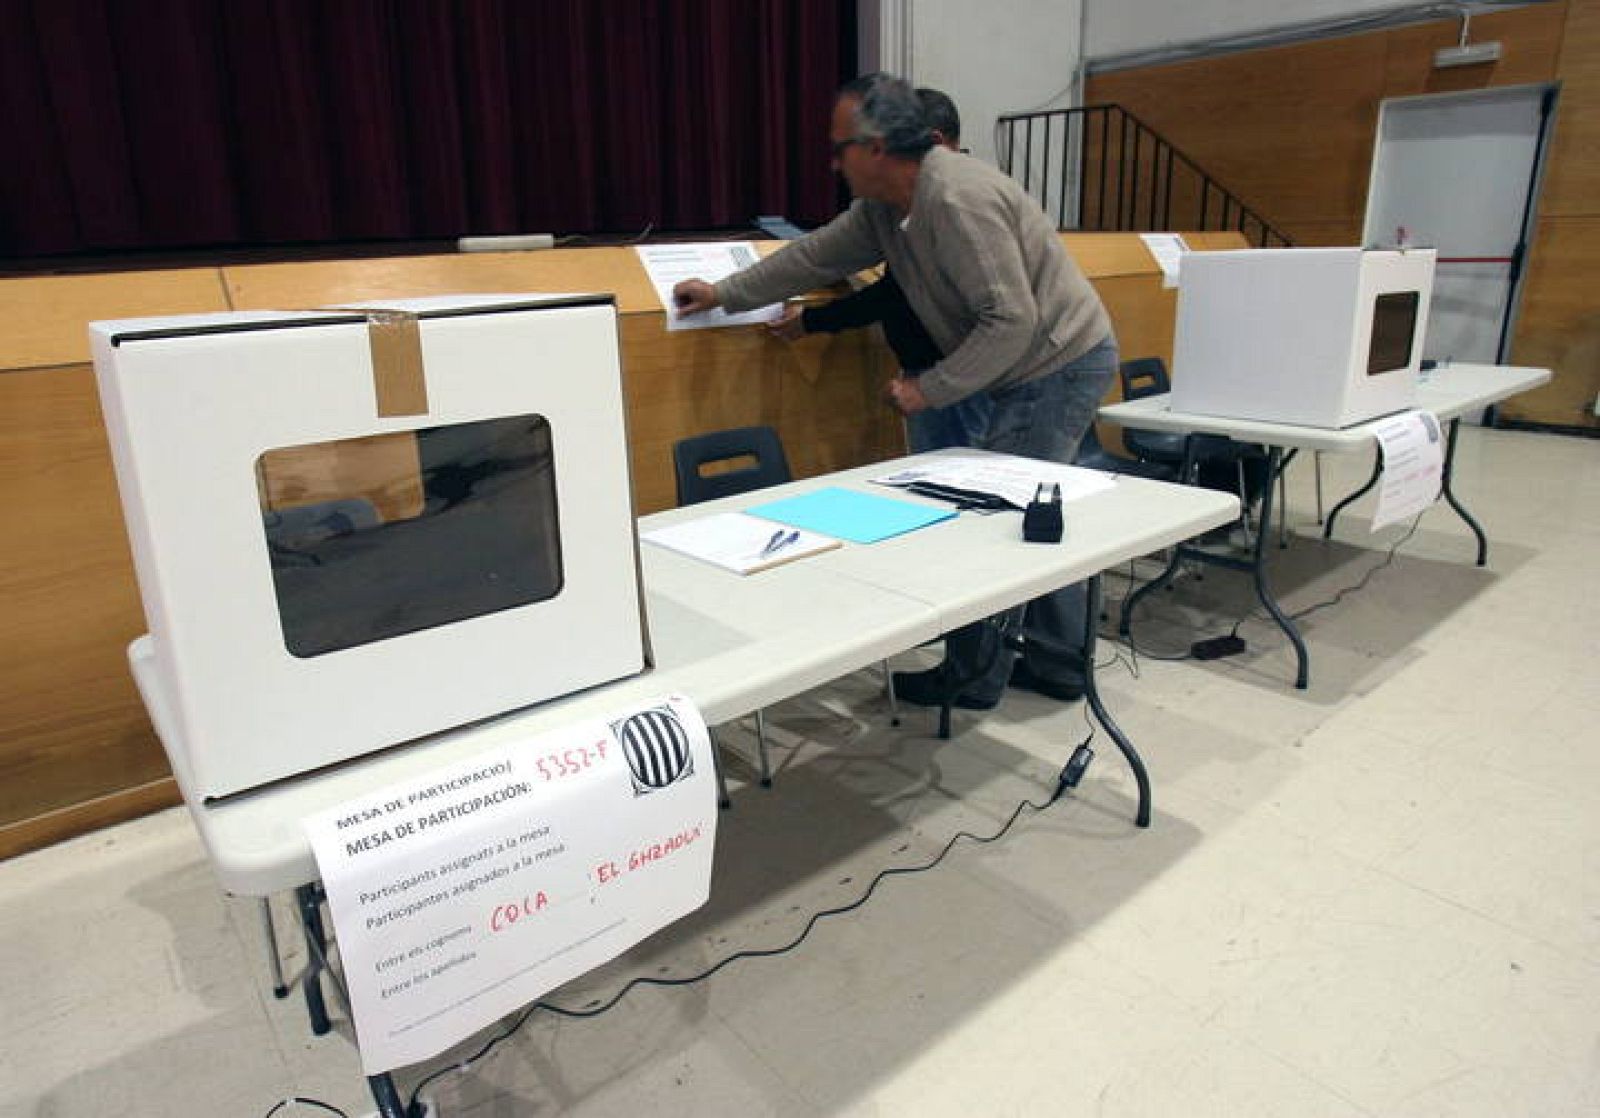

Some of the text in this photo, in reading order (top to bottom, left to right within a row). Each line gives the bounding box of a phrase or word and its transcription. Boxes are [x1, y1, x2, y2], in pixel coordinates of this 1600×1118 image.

[337, 807, 383, 830] MESA
[385, 798, 406, 814] DE
[346, 829, 394, 857] MESA
[395, 821, 416, 839] DE
[360, 825, 551, 906] Participants assignats a la mesa
[596, 861, 621, 884] EL
[366, 843, 567, 930] Participantes asignados a la mesa
[382, 979, 413, 999] Entre
